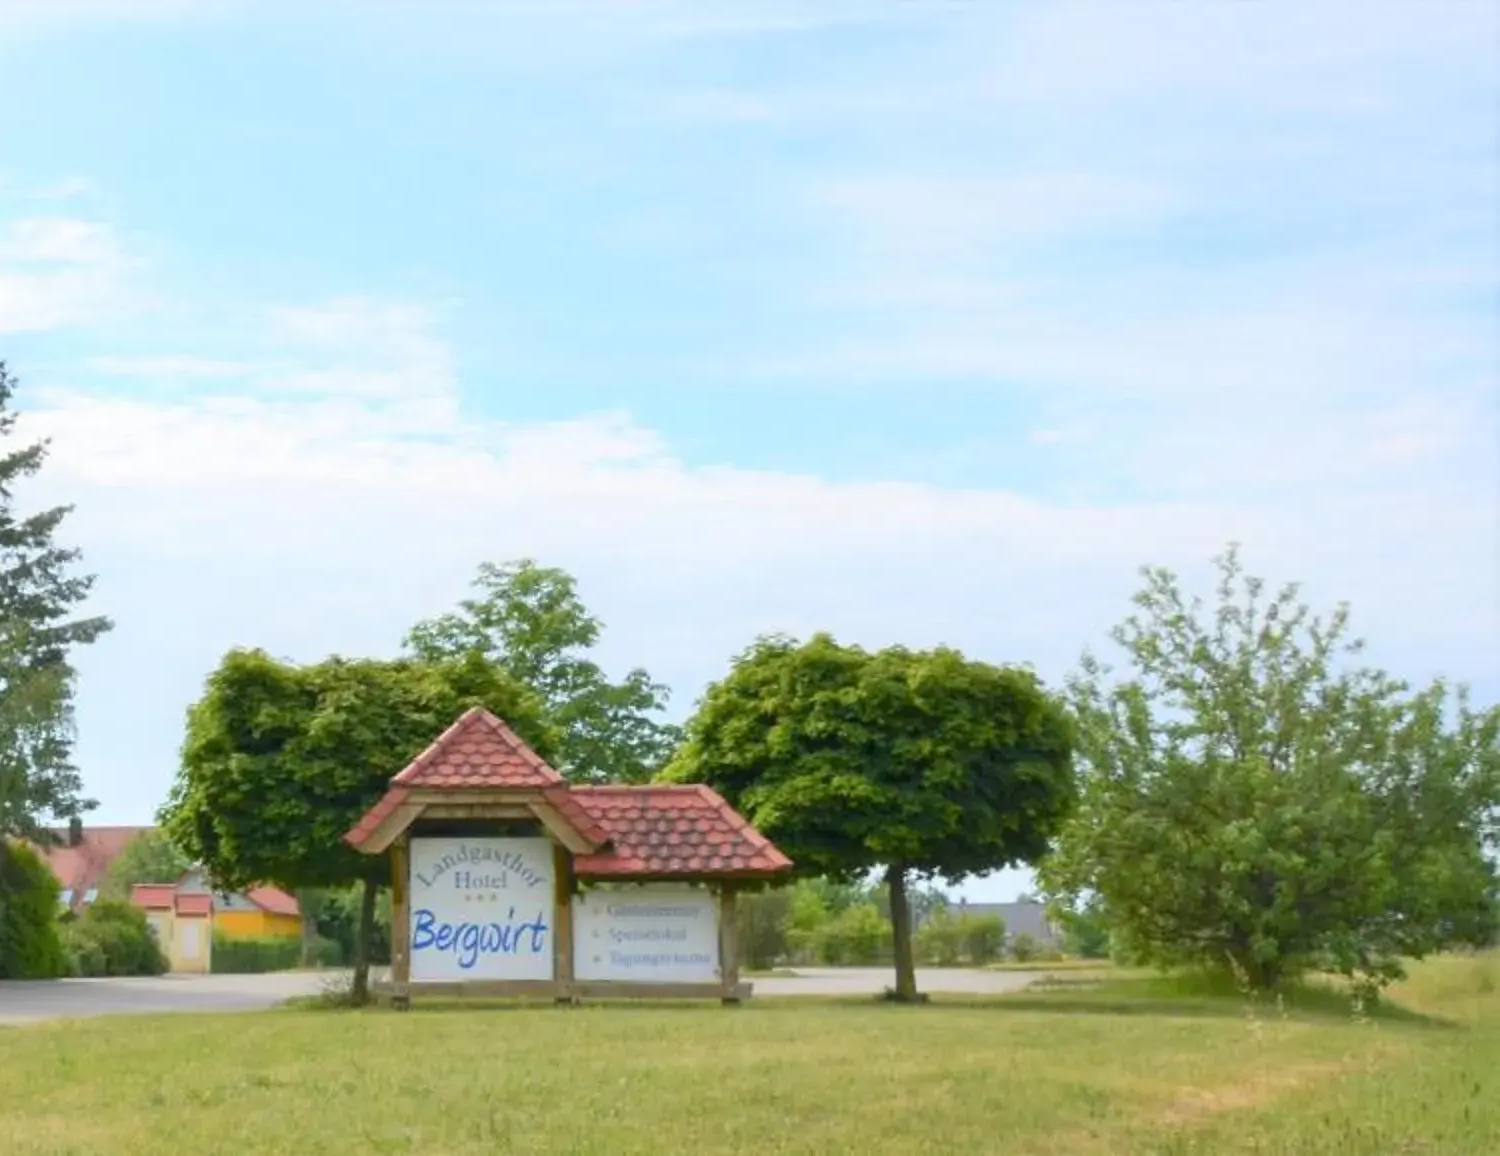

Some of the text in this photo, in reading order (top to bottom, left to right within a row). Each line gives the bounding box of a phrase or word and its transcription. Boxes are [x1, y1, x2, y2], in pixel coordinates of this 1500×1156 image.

[415, 844, 548, 888] Landgasthof
[454, 870, 508, 889] Hotel
[412, 908, 547, 968] Bergwirt
